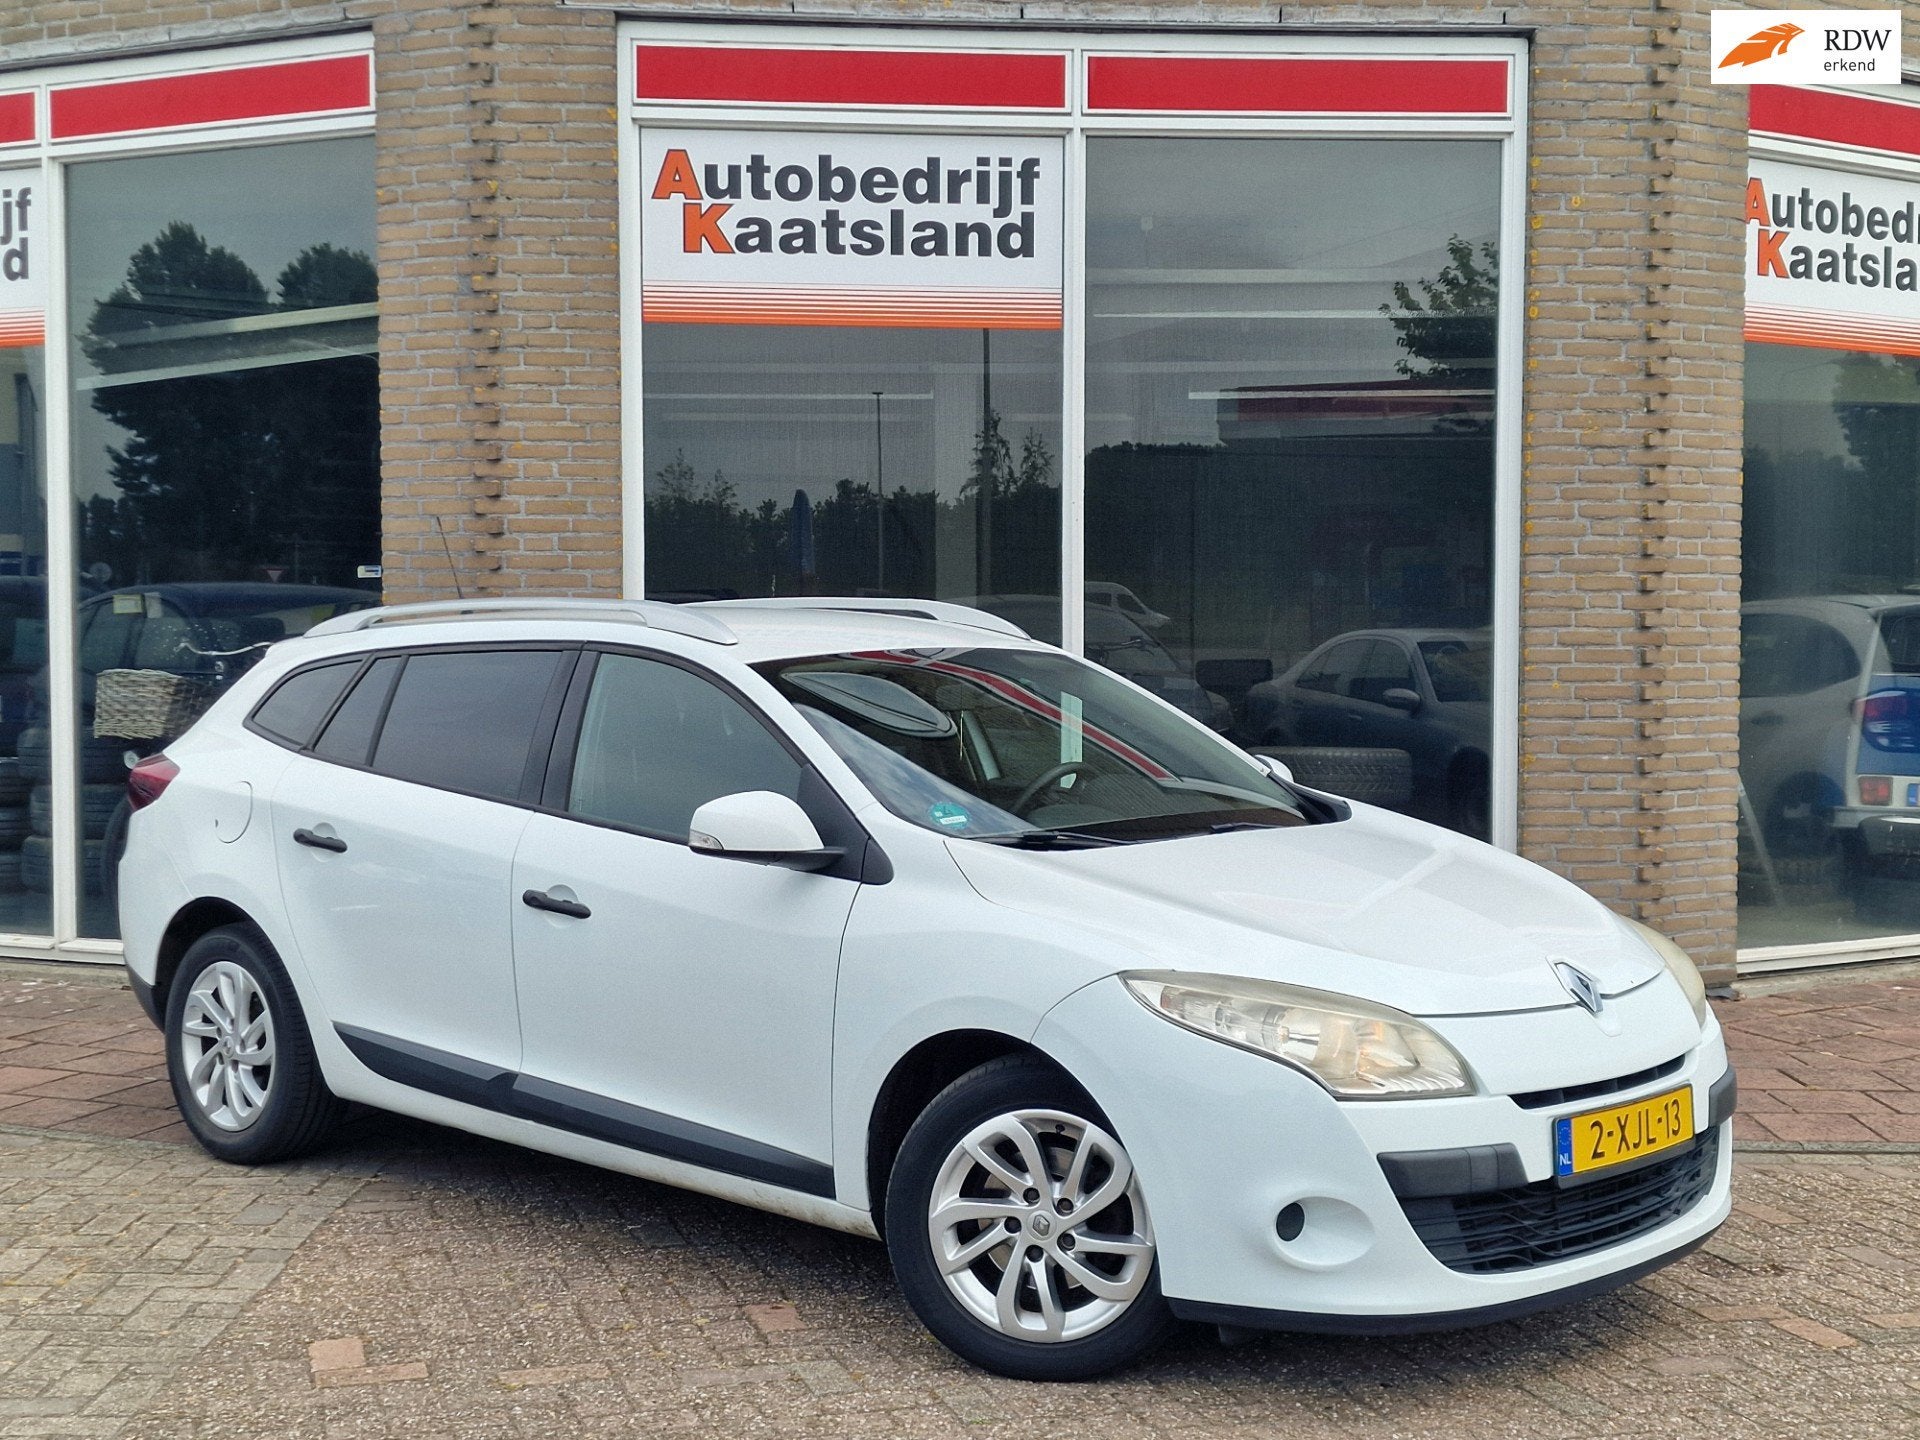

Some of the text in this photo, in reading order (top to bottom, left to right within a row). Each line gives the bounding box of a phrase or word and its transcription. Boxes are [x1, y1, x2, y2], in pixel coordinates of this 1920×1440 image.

[651, 148, 1041, 219] Autobedrijf
[1745, 177, 1920, 245] Autobed
[682, 202, 1035, 259] Kaatsland
[1757, 228, 1918, 292] Kaatsla
[1559, 1152, 1572, 1167] NL
[1589, 1098, 1681, 1160] 2-XJL-13
